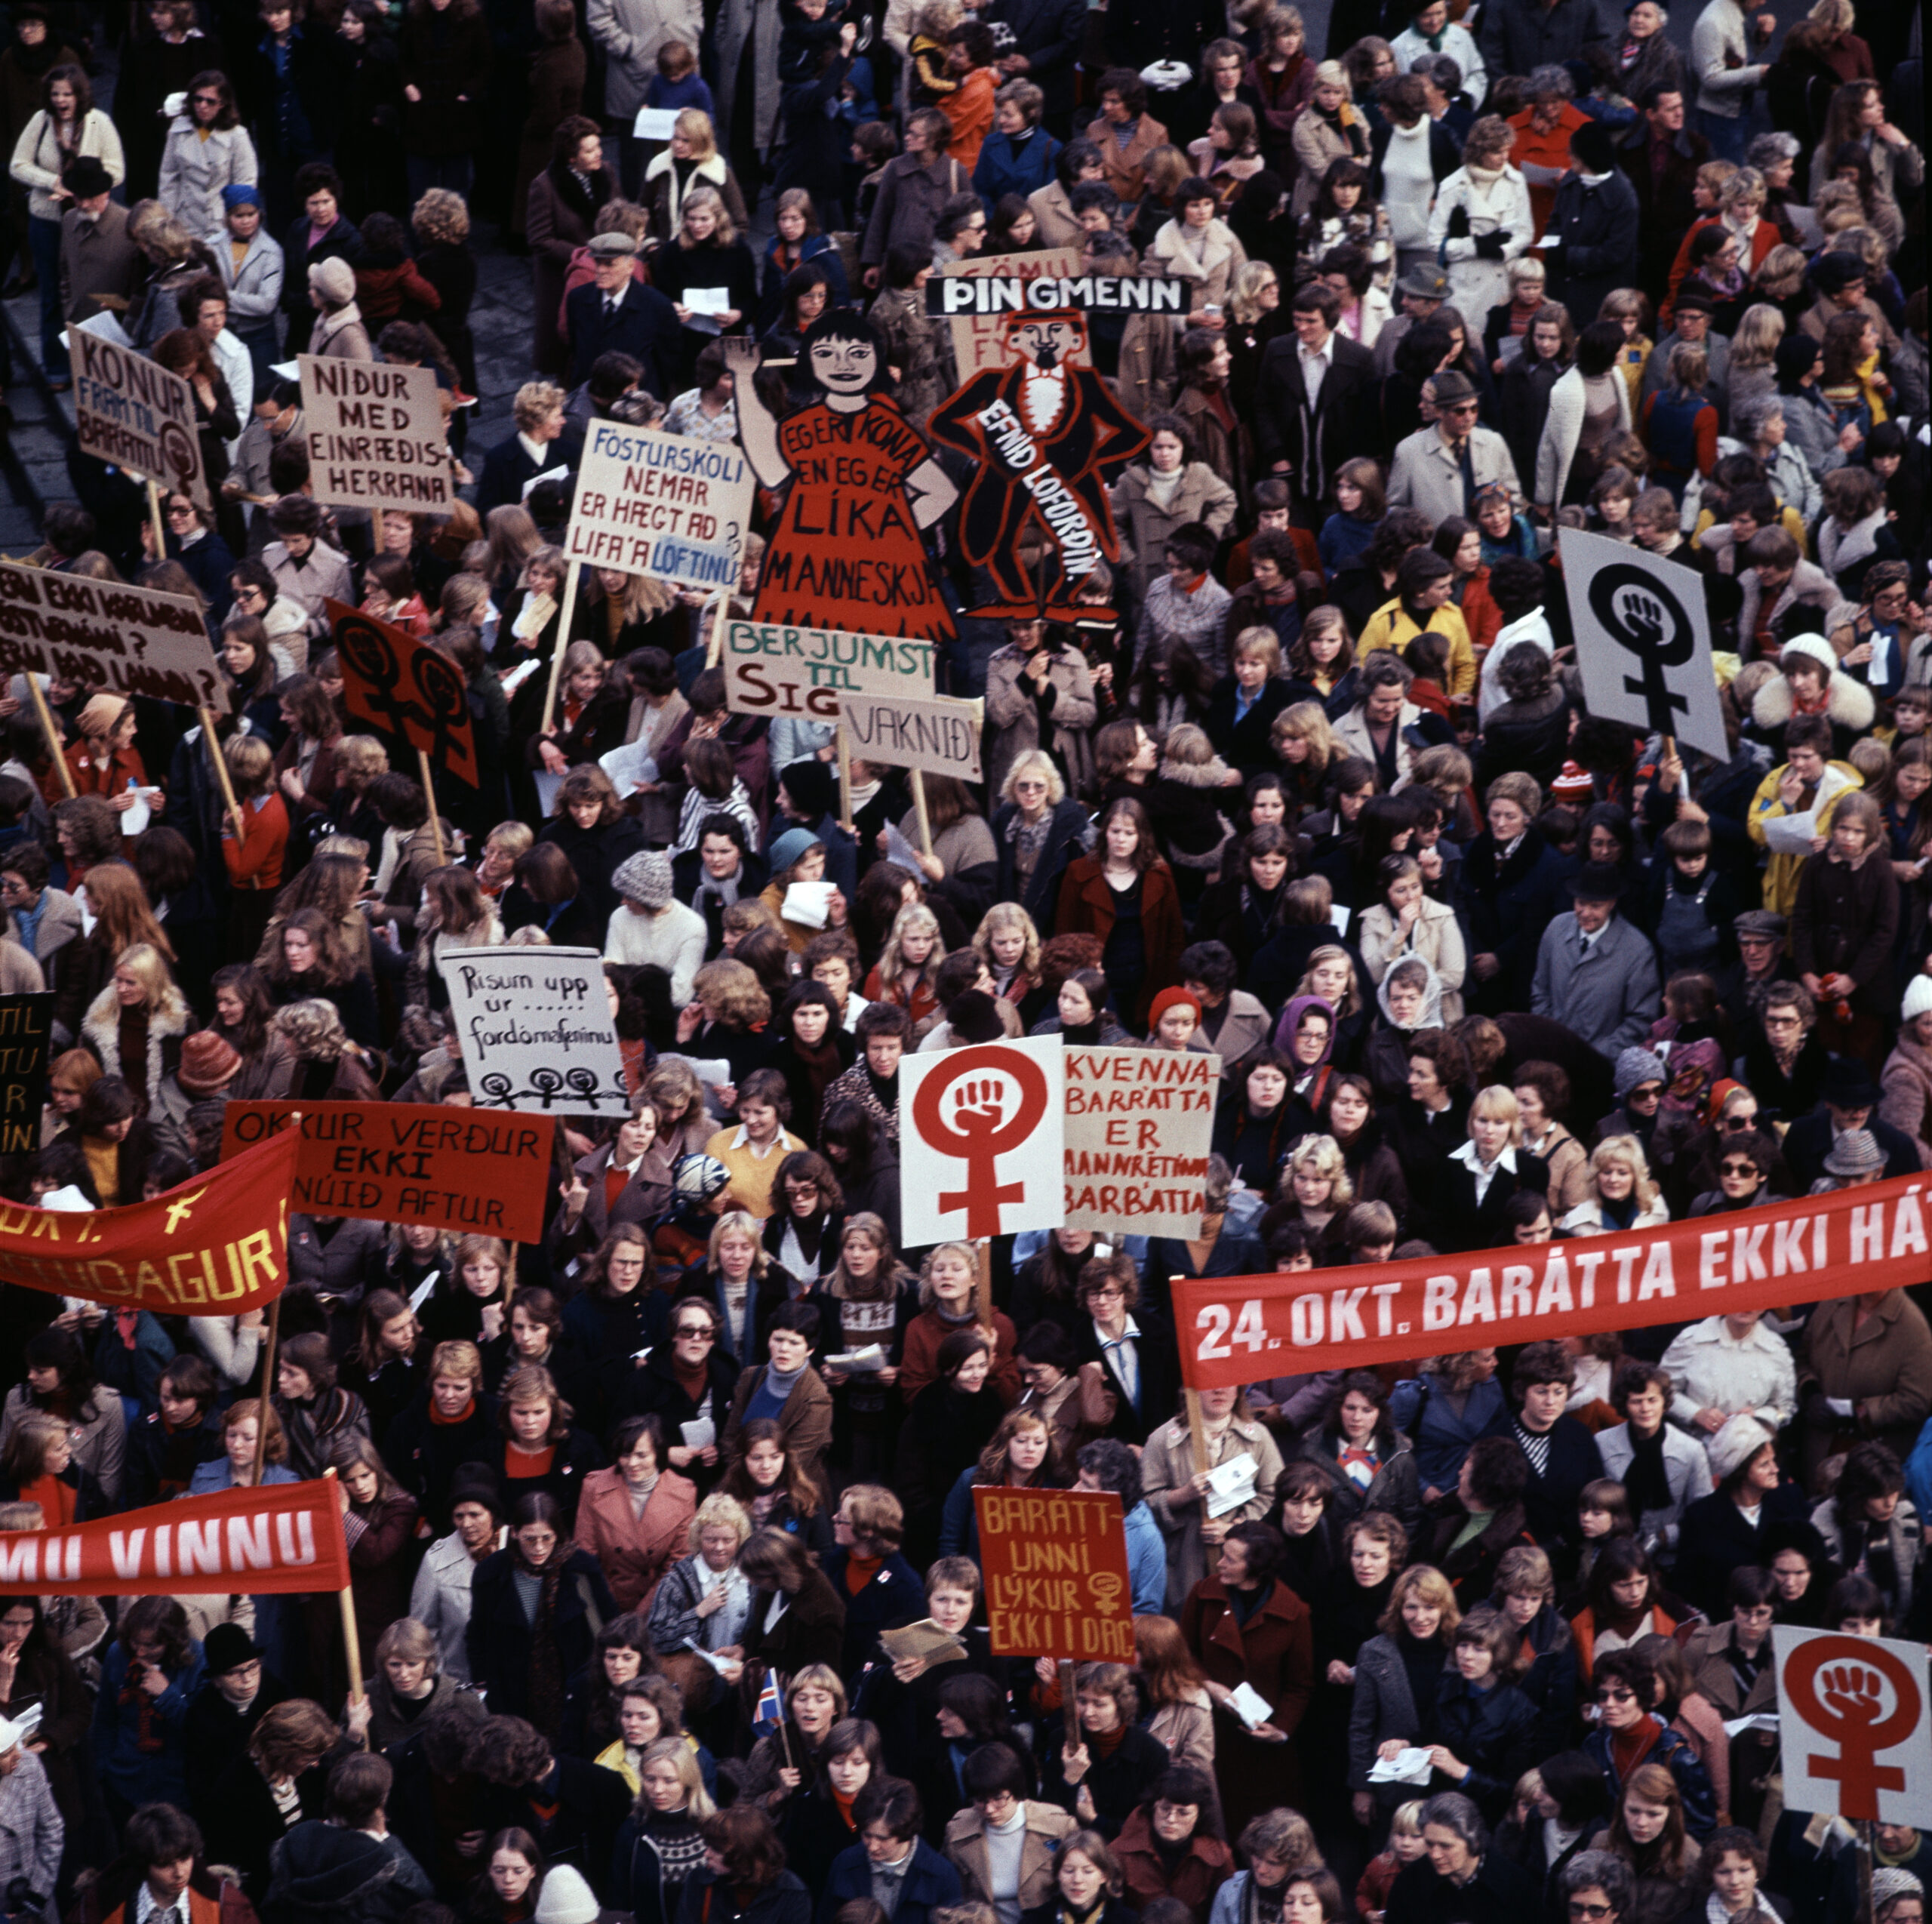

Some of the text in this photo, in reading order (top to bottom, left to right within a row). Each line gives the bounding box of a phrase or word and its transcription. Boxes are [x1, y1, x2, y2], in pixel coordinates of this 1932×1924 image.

[943, 276, 1181, 313] ÞINGMENN
[82, 334, 189, 426] KONUR
[858, 413, 924, 472] KONA
[329, 467, 446, 503] HERRANA
[623, 466, 709, 506] NEMAR
[580, 491, 606, 519] ER
[612, 497, 684, 533] HÆGT
[792, 488, 913, 541] LÍKA
[571, 526, 624, 562] LIFA
[729, 622, 933, 679] BERJUMST
[737, 663, 840, 716] SIG
[804, 661, 862, 691] TIL
[544, 977, 589, 1000] upp
[1065, 1054, 1220, 1085] KVENNA-
[392, 1119, 540, 1159] VERÐUR
[1106, 1119, 1161, 1150] ER
[334, 1146, 433, 1180] EKKI
[1195, 1184, 1932, 1361] 24. OKT. BARÁTTA EKKI HÁ
[109, 1510, 316, 1579] VINNU
[992, 1572, 1082, 1612] LÝKUR
[991, 1610, 1054, 1650] EKKI
[1082, 1617, 1134, 1658] DAG
